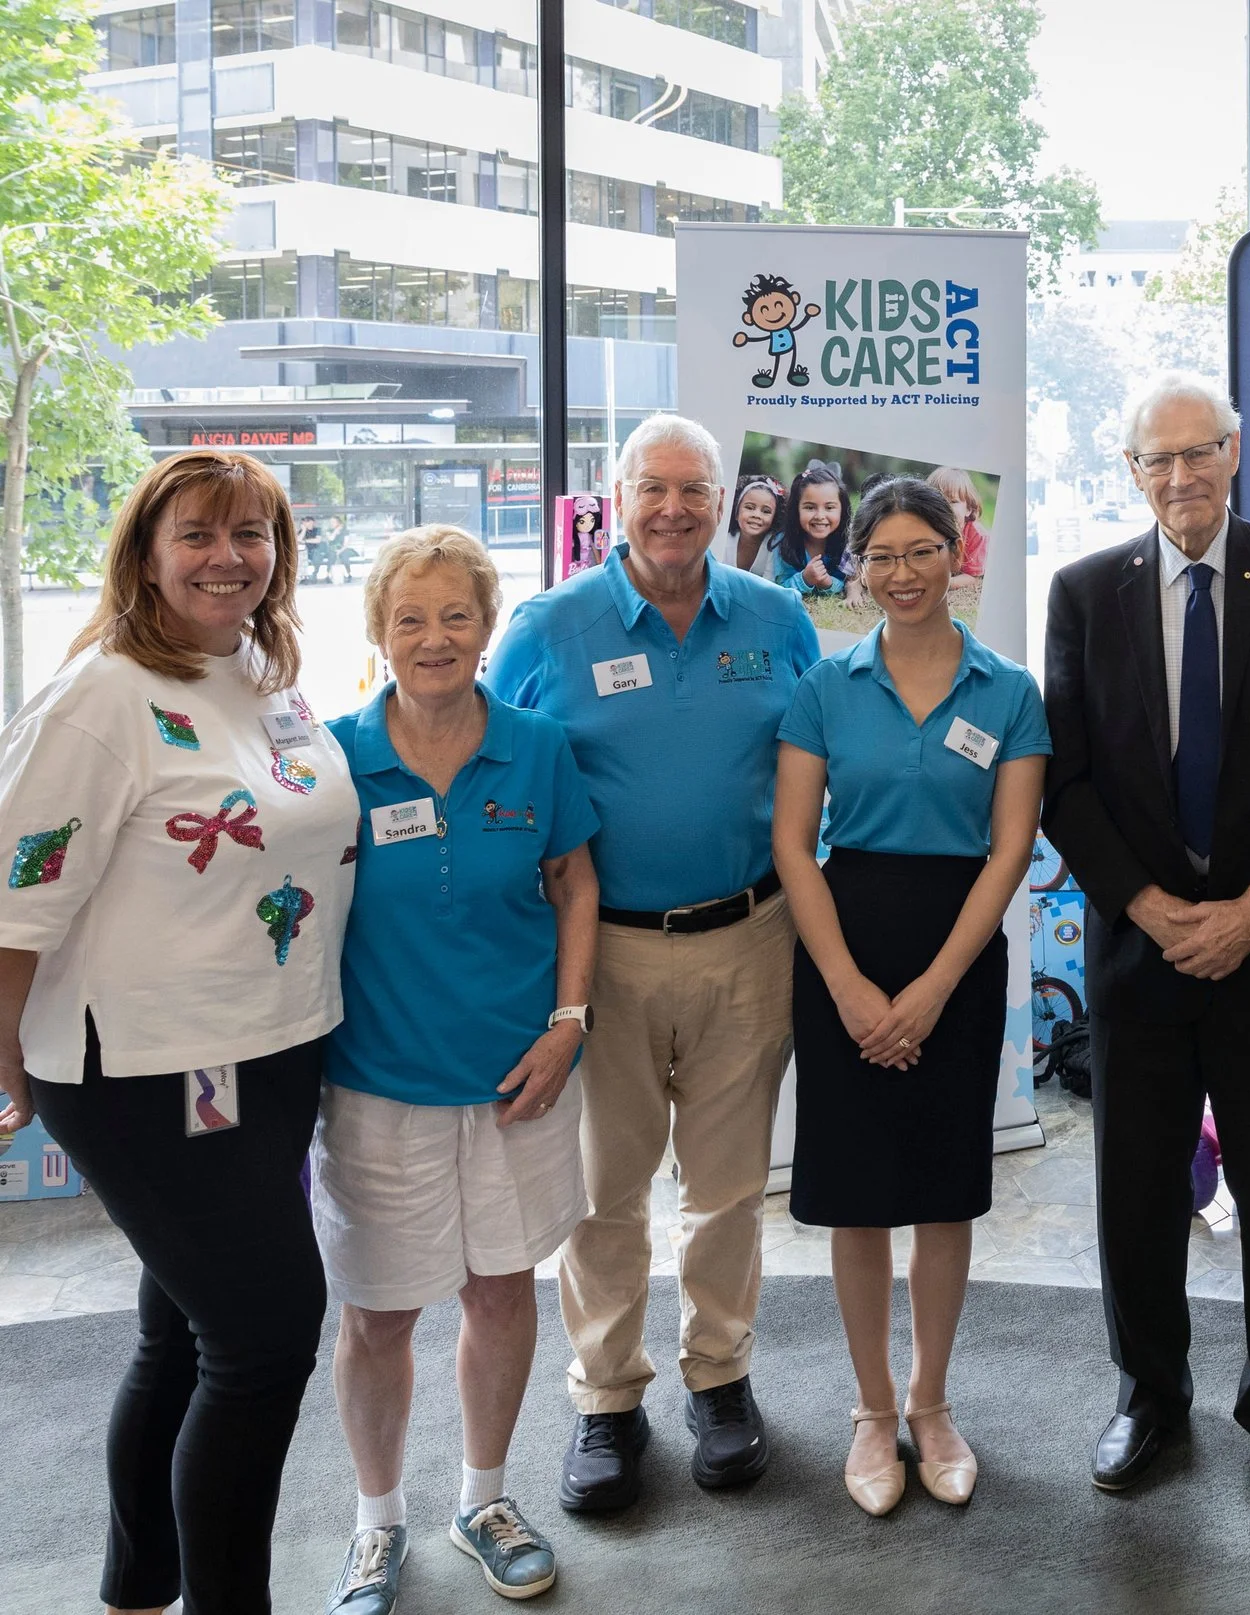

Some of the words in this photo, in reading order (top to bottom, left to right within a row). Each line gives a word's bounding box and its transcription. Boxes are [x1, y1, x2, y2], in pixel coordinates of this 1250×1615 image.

[825, 278, 941, 334] KIDS
[885, 293, 904, 319] in
[946, 279, 980, 385] ACT
[820, 335, 942, 388] CARE
[747, 395, 797, 408] Proudly
[801, 394, 867, 408] Supported
[871, 394, 887, 407] by
[891, 394, 921, 405] ACT
[925, 394, 980, 407] Policing
[191, 432, 235, 446] ALICIA
[241, 431, 289, 446] PAYNE
[292, 431, 315, 445] MP
[487, 484, 502, 492] FOR
[612, 678, 638, 690] Gary
[959, 743, 979, 759] Jess
[385, 823, 427, 840] Sandra
